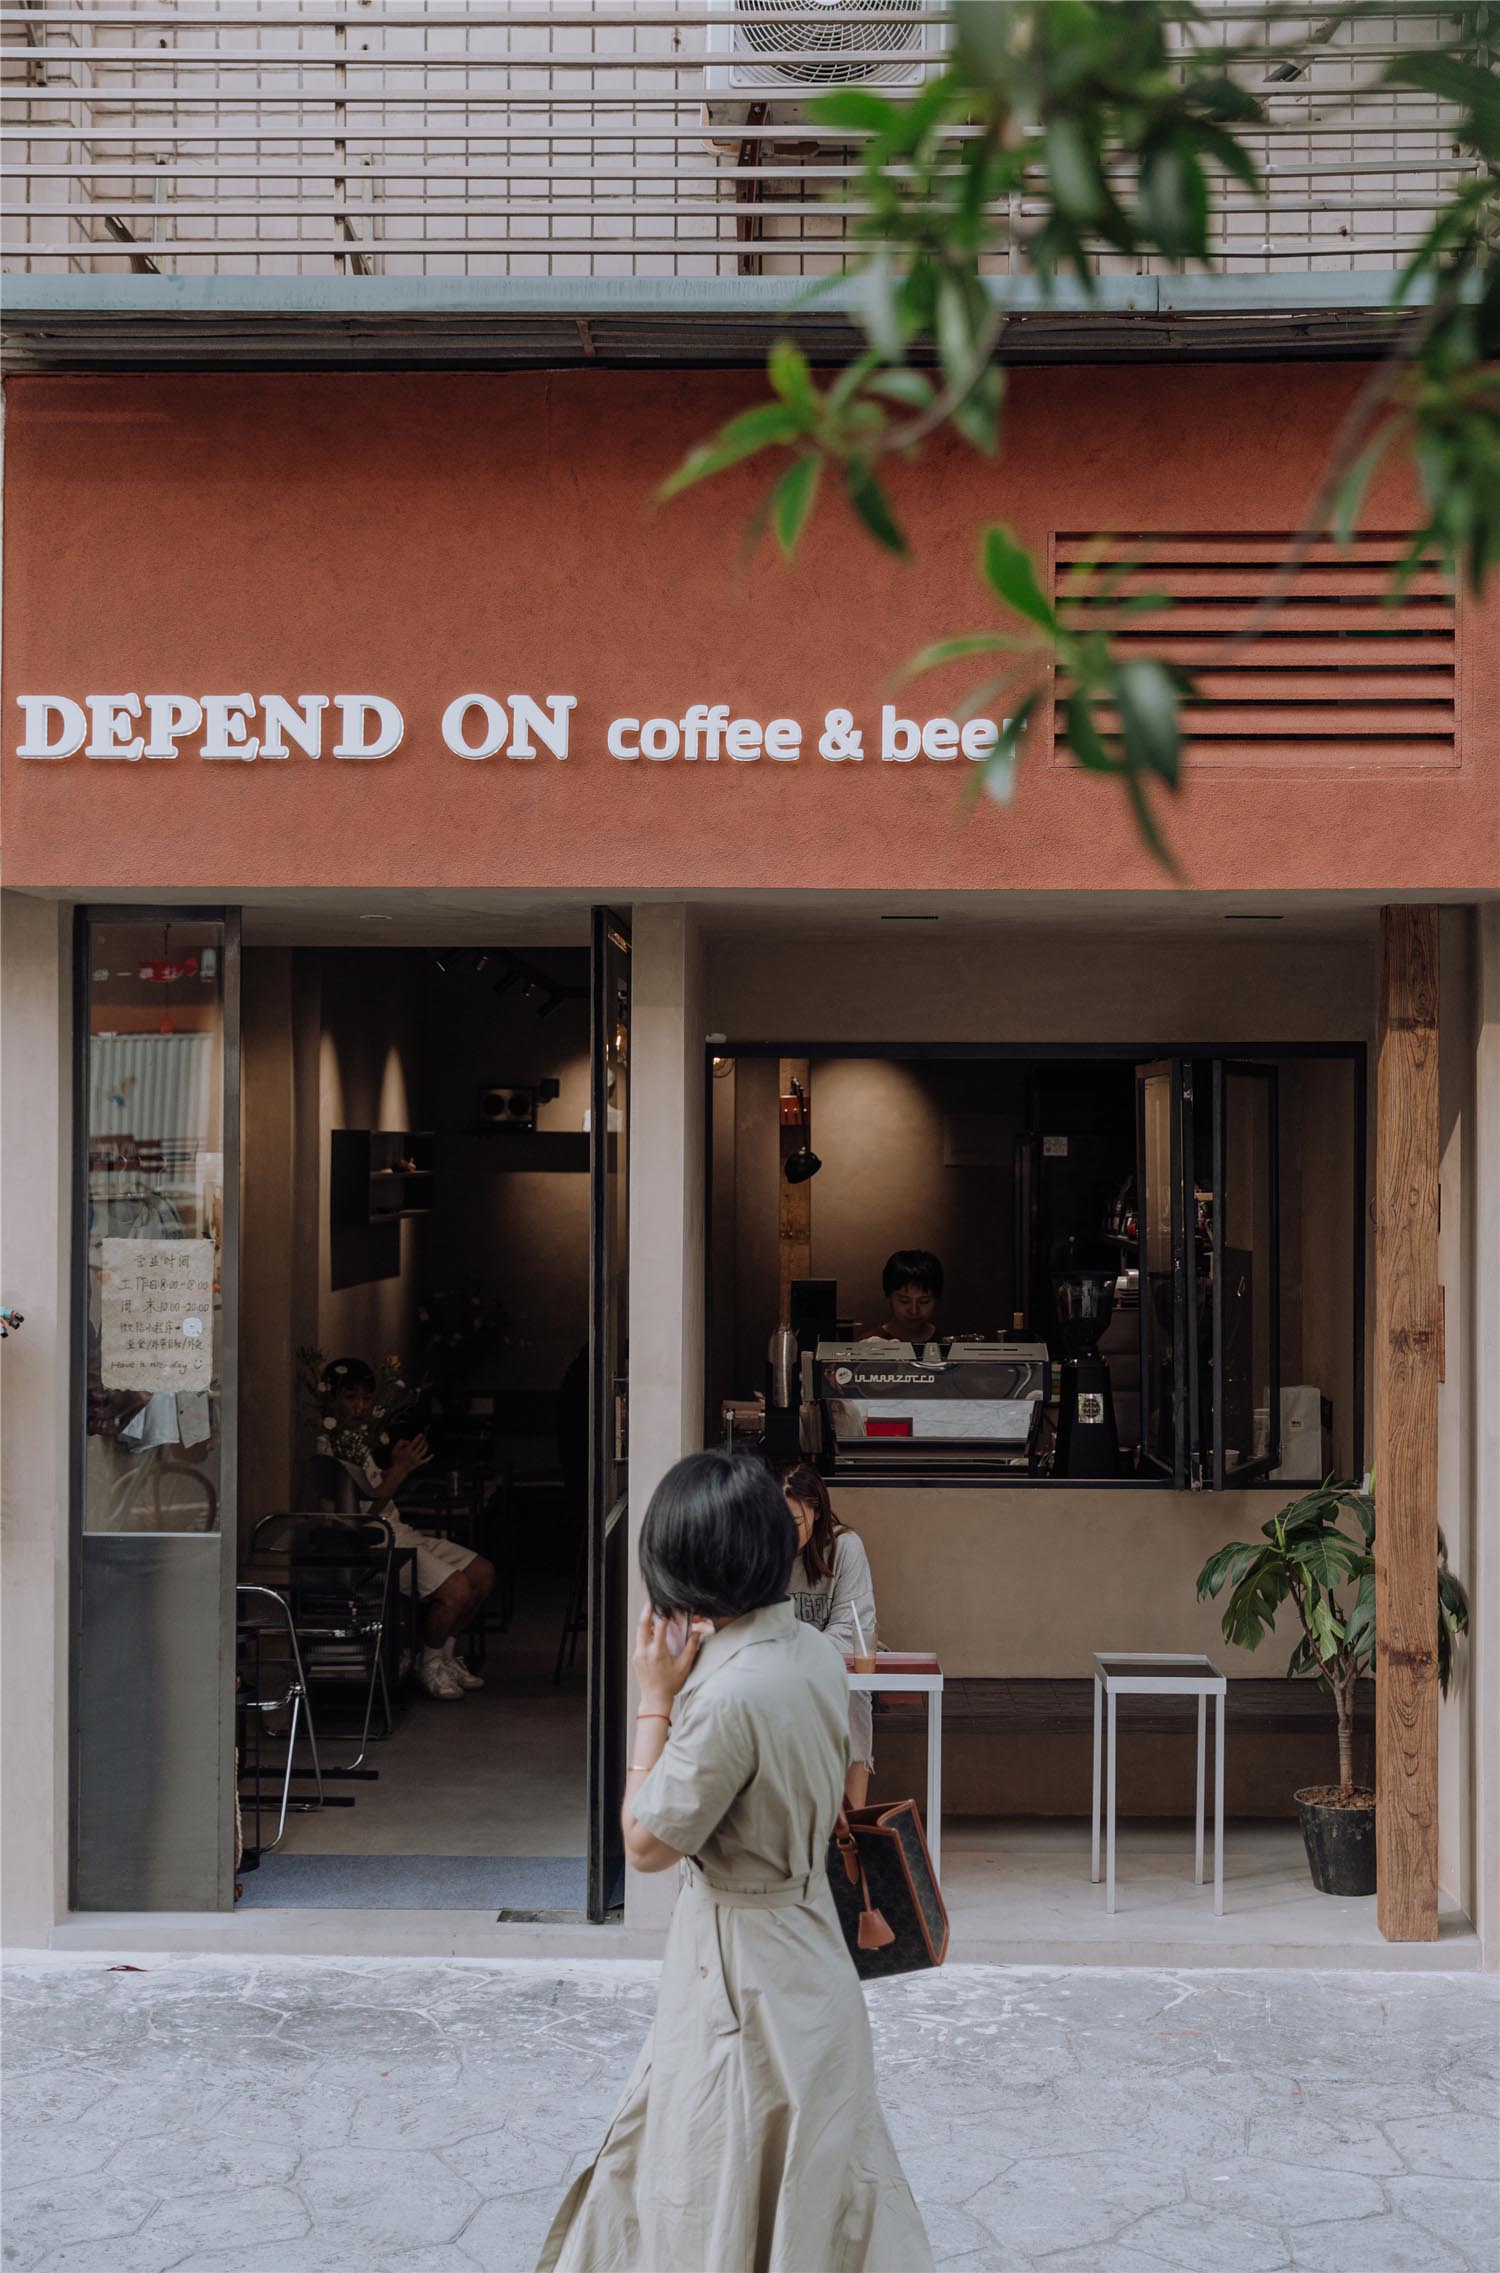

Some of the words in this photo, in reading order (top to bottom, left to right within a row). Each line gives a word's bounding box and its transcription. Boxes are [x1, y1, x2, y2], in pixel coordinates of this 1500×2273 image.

[16, 692, 404, 762] DEPEND
[441, 693, 578, 761] ON
[607, 704, 803, 762] coffee
[818, 708, 864, 762] &
[134, 1253, 190, 1268] 营业时间
